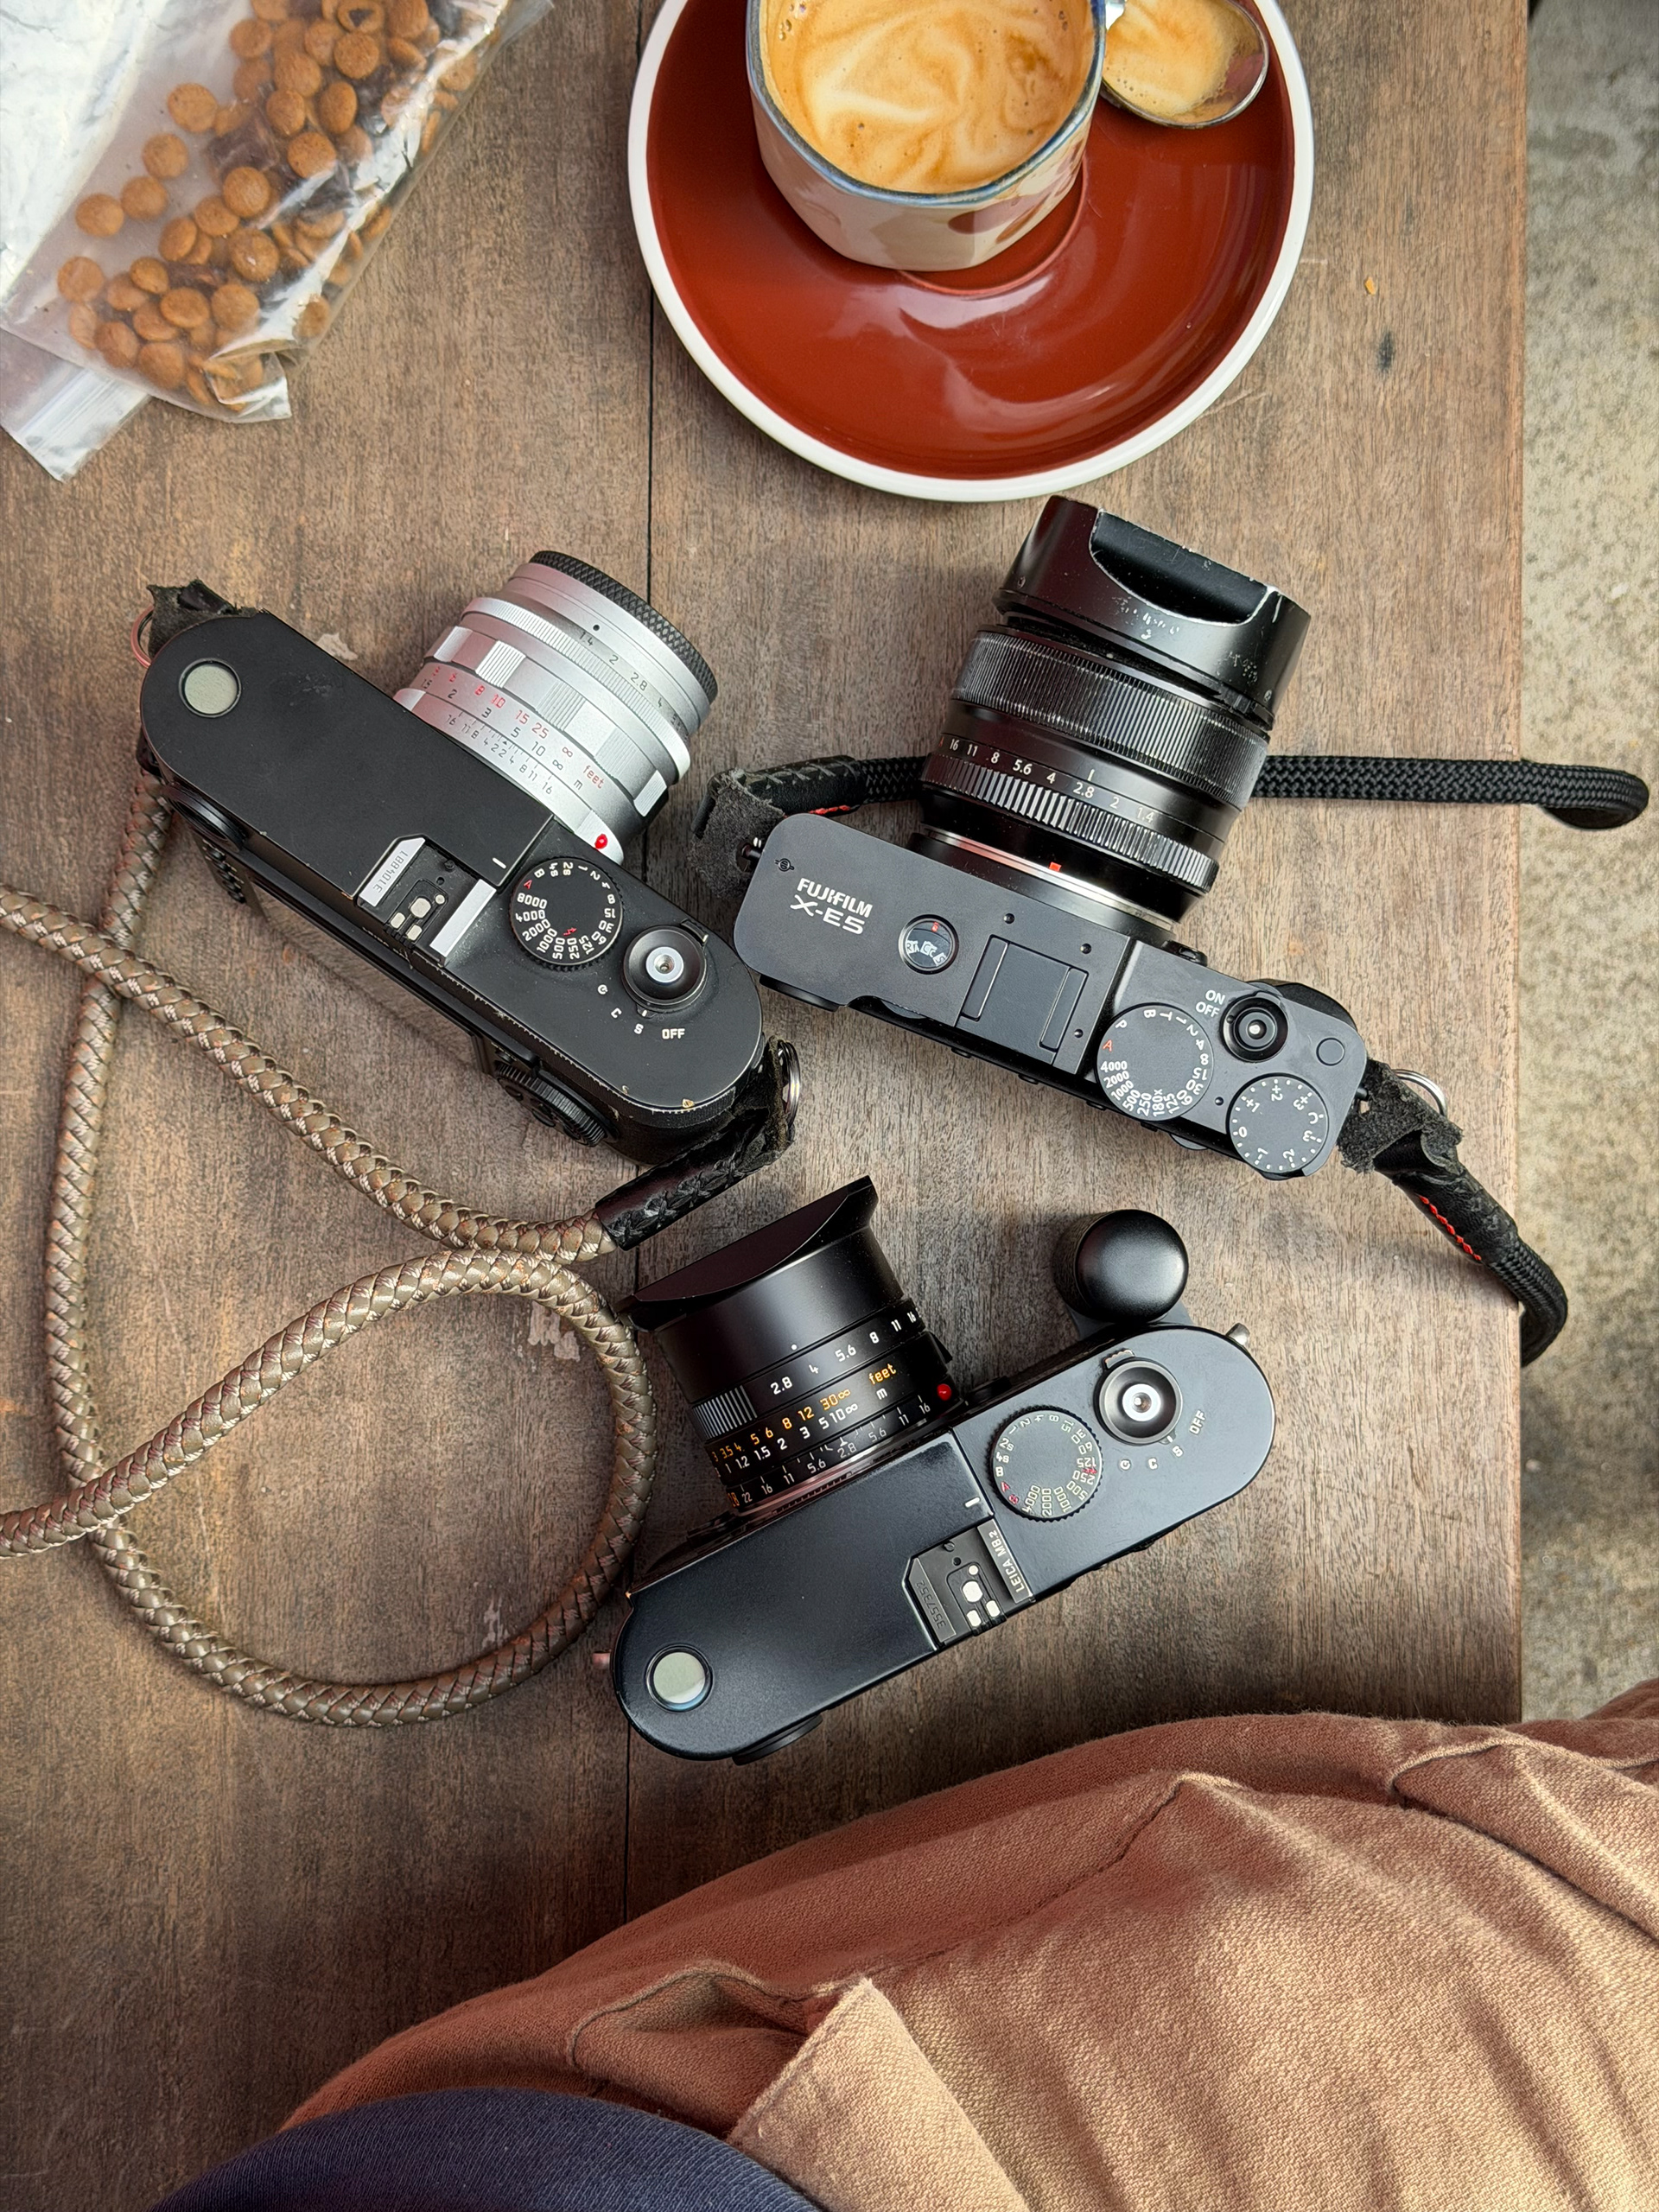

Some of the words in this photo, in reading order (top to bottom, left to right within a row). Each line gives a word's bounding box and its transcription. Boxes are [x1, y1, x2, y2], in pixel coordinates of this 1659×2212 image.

[609, 654, 619, 665] 2
[631, 671, 648, 691] 2.8
[658, 697, 663, 708] 4
[448, 689, 457, 699] 2
[481, 707, 492, 718] 3
[511, 727, 521, 738] 5
[531, 741, 546, 757] 10
[574, 779, 583, 790] m
[474, 685, 486, 696] 8
[491, 694, 506, 709] 10
[515, 709, 530, 724] 15
[531, 722, 550, 739] 25
[582, 765, 604, 789] feet
[446, 714, 457, 726] 16
[471, 730, 480, 740] 8
[483, 737, 488, 746] 4
[491, 743, 499, 753] 2
[499, 748, 507, 758] 2
[509, 755, 514, 764] 4
[519, 764, 528, 773] 8
[528, 770, 537, 781] 11
[542, 782, 553, 795] 16
[950, 738, 959, 751] 16
[967, 744, 978, 757] 11
[990, 752, 1000, 764] 8
[1013, 759, 1033, 775] 5.6
[1046, 772, 1056, 784] 4
[1073, 781, 1095, 798] 2.8
[1109, 796, 1120, 809] 2
[1136, 807, 1155, 823] 1.4
[590, 870, 601, 880] 2
[524, 880, 533, 889] A
[517, 893, 547, 909] 8000
[607, 893, 615, 904] 8
[797, 877, 873, 918] FUJIFILM
[515, 909, 545, 922] 4000
[604, 908, 616, 918] 15
[790, 894, 865, 935] X-E5
[522, 918, 550, 941] 2000
[598, 919, 614, 933] 30
[537, 928, 557, 953] 1000
[578, 935, 594, 955] 125
[591, 931, 607, 945] 60
[552, 937, 565, 959] 500
[567, 938, 580, 959] 250
[1205, 990, 1225, 1005] ON
[611, 1007, 622, 1019] C
[1144, 1009, 1156, 1018] B
[1160, 1011, 1173, 1021] T
[1196, 1001, 1220, 1018] OFF
[634, 1023, 644, 1034] S
[1115, 1020, 1128, 1028] P
[1186, 1024, 1198, 1036] 2
[662, 1028, 685, 1039] OFF
[1103, 1039, 1113, 1052] A
[1195, 1039, 1205, 1050] 4
[1100, 1060, 1128, 1072] 4000
[1200, 1053, 1209, 1065] 8
[1103, 1071, 1129, 1088] 2000
[1192, 1067, 1208, 1080] 15
[1110, 1080, 1134, 1101] 1000
[1185, 1079, 1204, 1095] 30
[1122, 1090, 1141, 1111] 500
[1136, 1092, 1152, 1116] 250
[1163, 1093, 1180, 1114] 125
[1176, 1090, 1193, 1106] 60
[1308, 1111, 1319, 1124] C
[1238, 1126, 1248, 1138] 0
[770, 1376, 793, 1395] 2.8
[808, 1363, 819, 1375] 4
[835, 1344, 856, 1362] 5.6
[869, 1332, 880, 1344] 8
[891, 1319, 902, 1332] 11
[750, 1433, 760, 1445] 5
[765, 1427, 774, 1439] 6
[782, 1417, 792, 1429] 8
[798, 1406, 815, 1421] 12
[868, 1363, 897, 1385] feet
[735, 1455, 750, 1470] 1.2
[753, 1446, 771, 1461] 1.5
[777, 1437, 788, 1451] 2
[799, 1426, 810, 1440] 3
[818, 1416, 830, 1430] 5
[829, 1408, 846, 1424] 10
[876, 1388, 888, 1400] m
[1008, 1426, 1017, 1434] 1
[1020, 1418, 1031, 1427] 2
[1061, 1420, 1074, 1433] 15
[1189, 1410, 1205, 1434] OFF
[1071, 1428, 1086, 1444] 30
[761, 1484, 773, 1495] 16
[783, 1472, 795, 1484] 11
[806, 1459, 827, 1474] 5.6
[837, 1442, 857, 1459] 2.8
[868, 1427, 887, 1443] 5.6
[899, 1414, 910, 1426] 11
[918, 1402, 931, 1414] 16
[1077, 1441, 1093, 1455] 60
[1172, 1446, 1184, 1458] S
[1077, 1457, 1096, 1468] 125
[1148, 1458, 1158, 1470] C
[995, 1466, 1004, 1477] B
[1072, 1470, 1096, 1485] 250
[1001, 1481, 1010, 1492] A
[1066, 1480, 1088, 1501] 500
[1021, 1484, 1041, 1513] 4000
[1041, 1488, 1052, 1517] 2000
[1053, 1486, 1072, 1513] 1000
[1002, 1558, 1025, 1593] LEICA
[916, 1580, 947, 1630] 3557352
